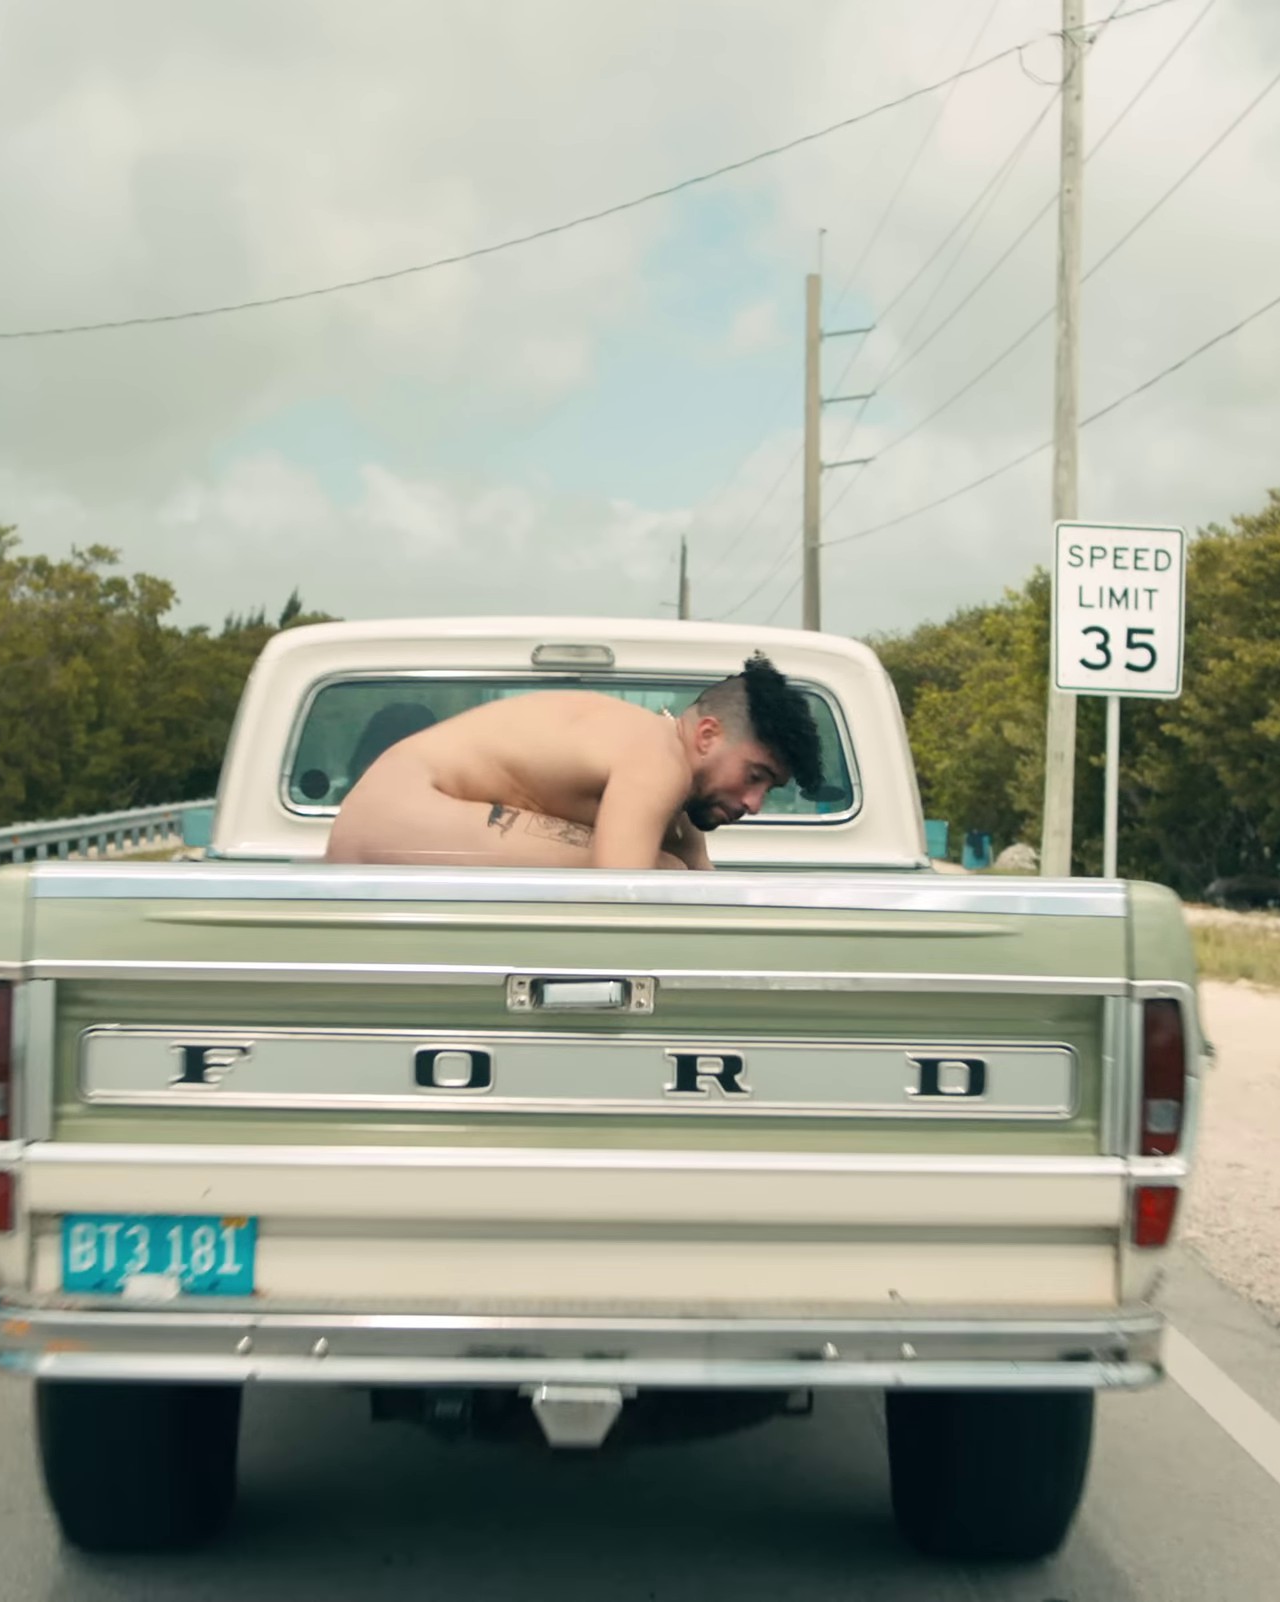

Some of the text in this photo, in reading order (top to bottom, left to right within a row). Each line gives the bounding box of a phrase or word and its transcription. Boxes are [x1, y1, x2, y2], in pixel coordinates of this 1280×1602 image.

[1068, 545, 1172, 571] SPEED
[1079, 585, 1159, 611] LIMIT
[1079, 625, 1157, 673] 35
[168, 1040, 989, 1101] FORD
[69, 1222, 244, 1276] BT3 181
